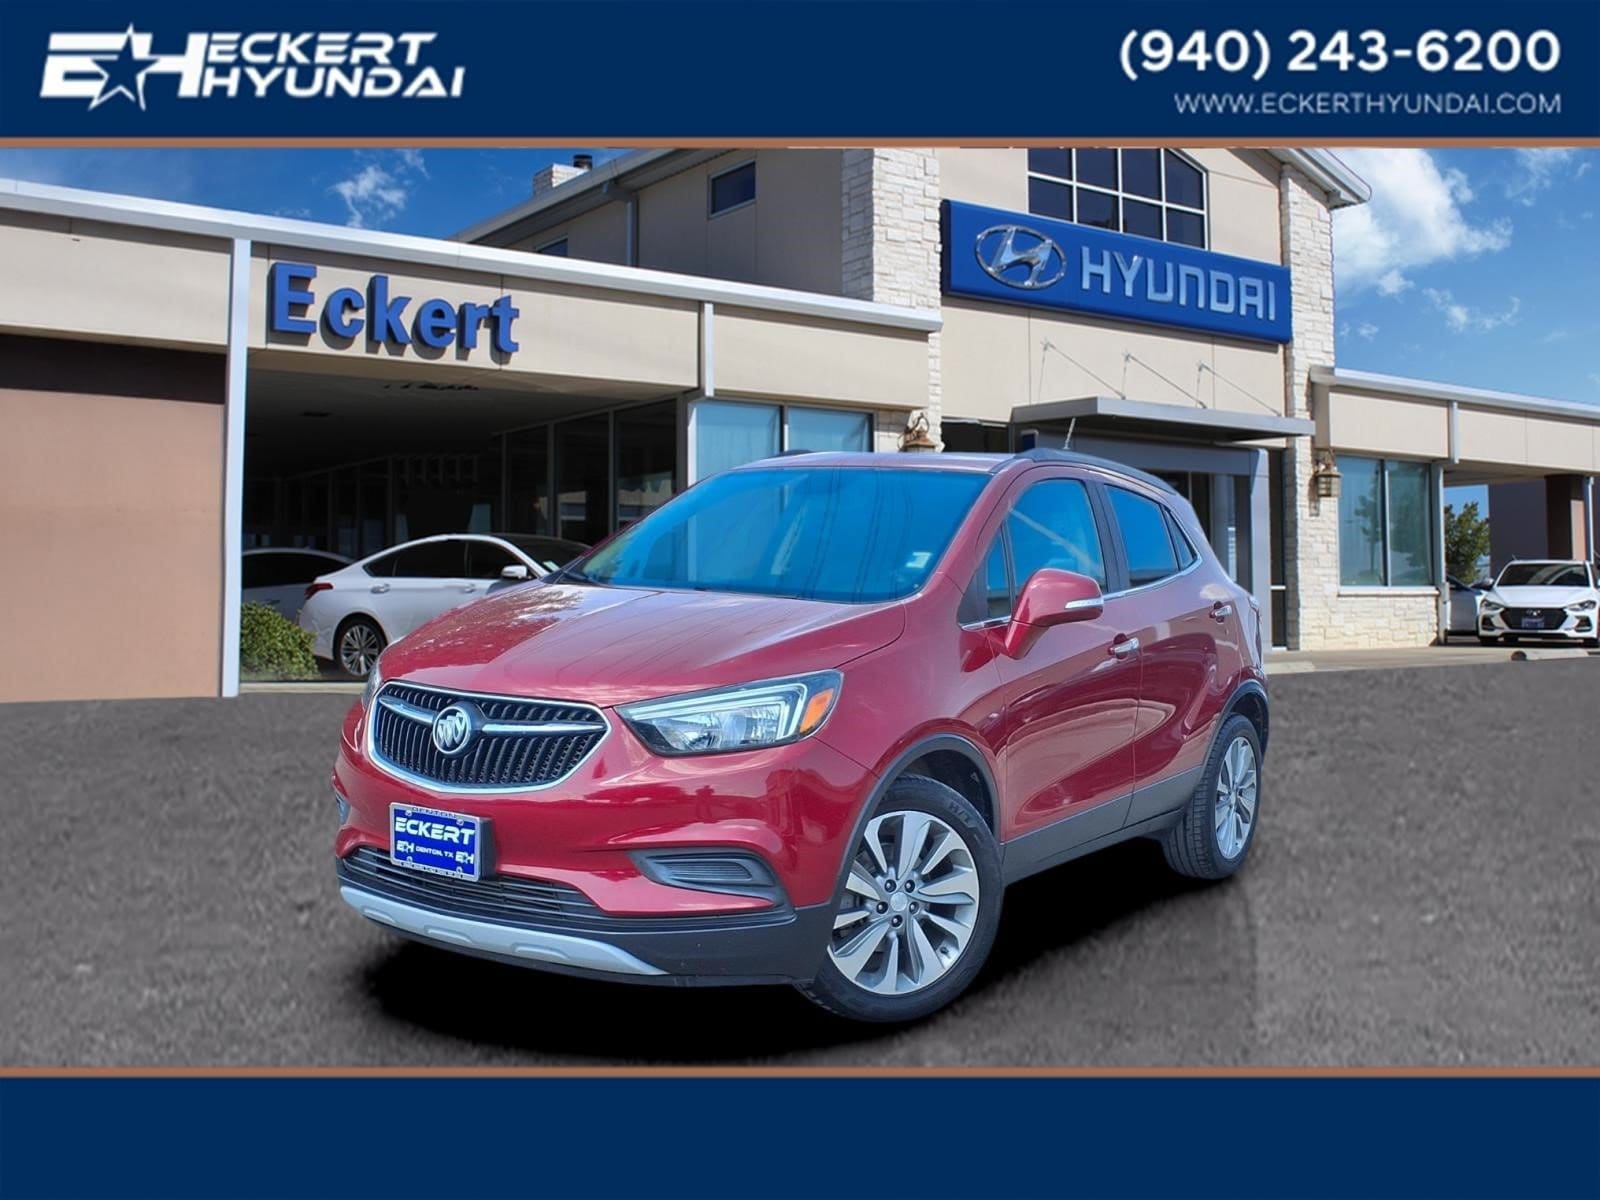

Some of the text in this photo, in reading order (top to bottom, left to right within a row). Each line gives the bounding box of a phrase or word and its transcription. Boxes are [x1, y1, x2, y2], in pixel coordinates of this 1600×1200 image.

[271, 261, 519, 352] Eckert
[1081, 246, 1276, 320] HYUNDAI
[395, 817, 475, 845] ECKERT
